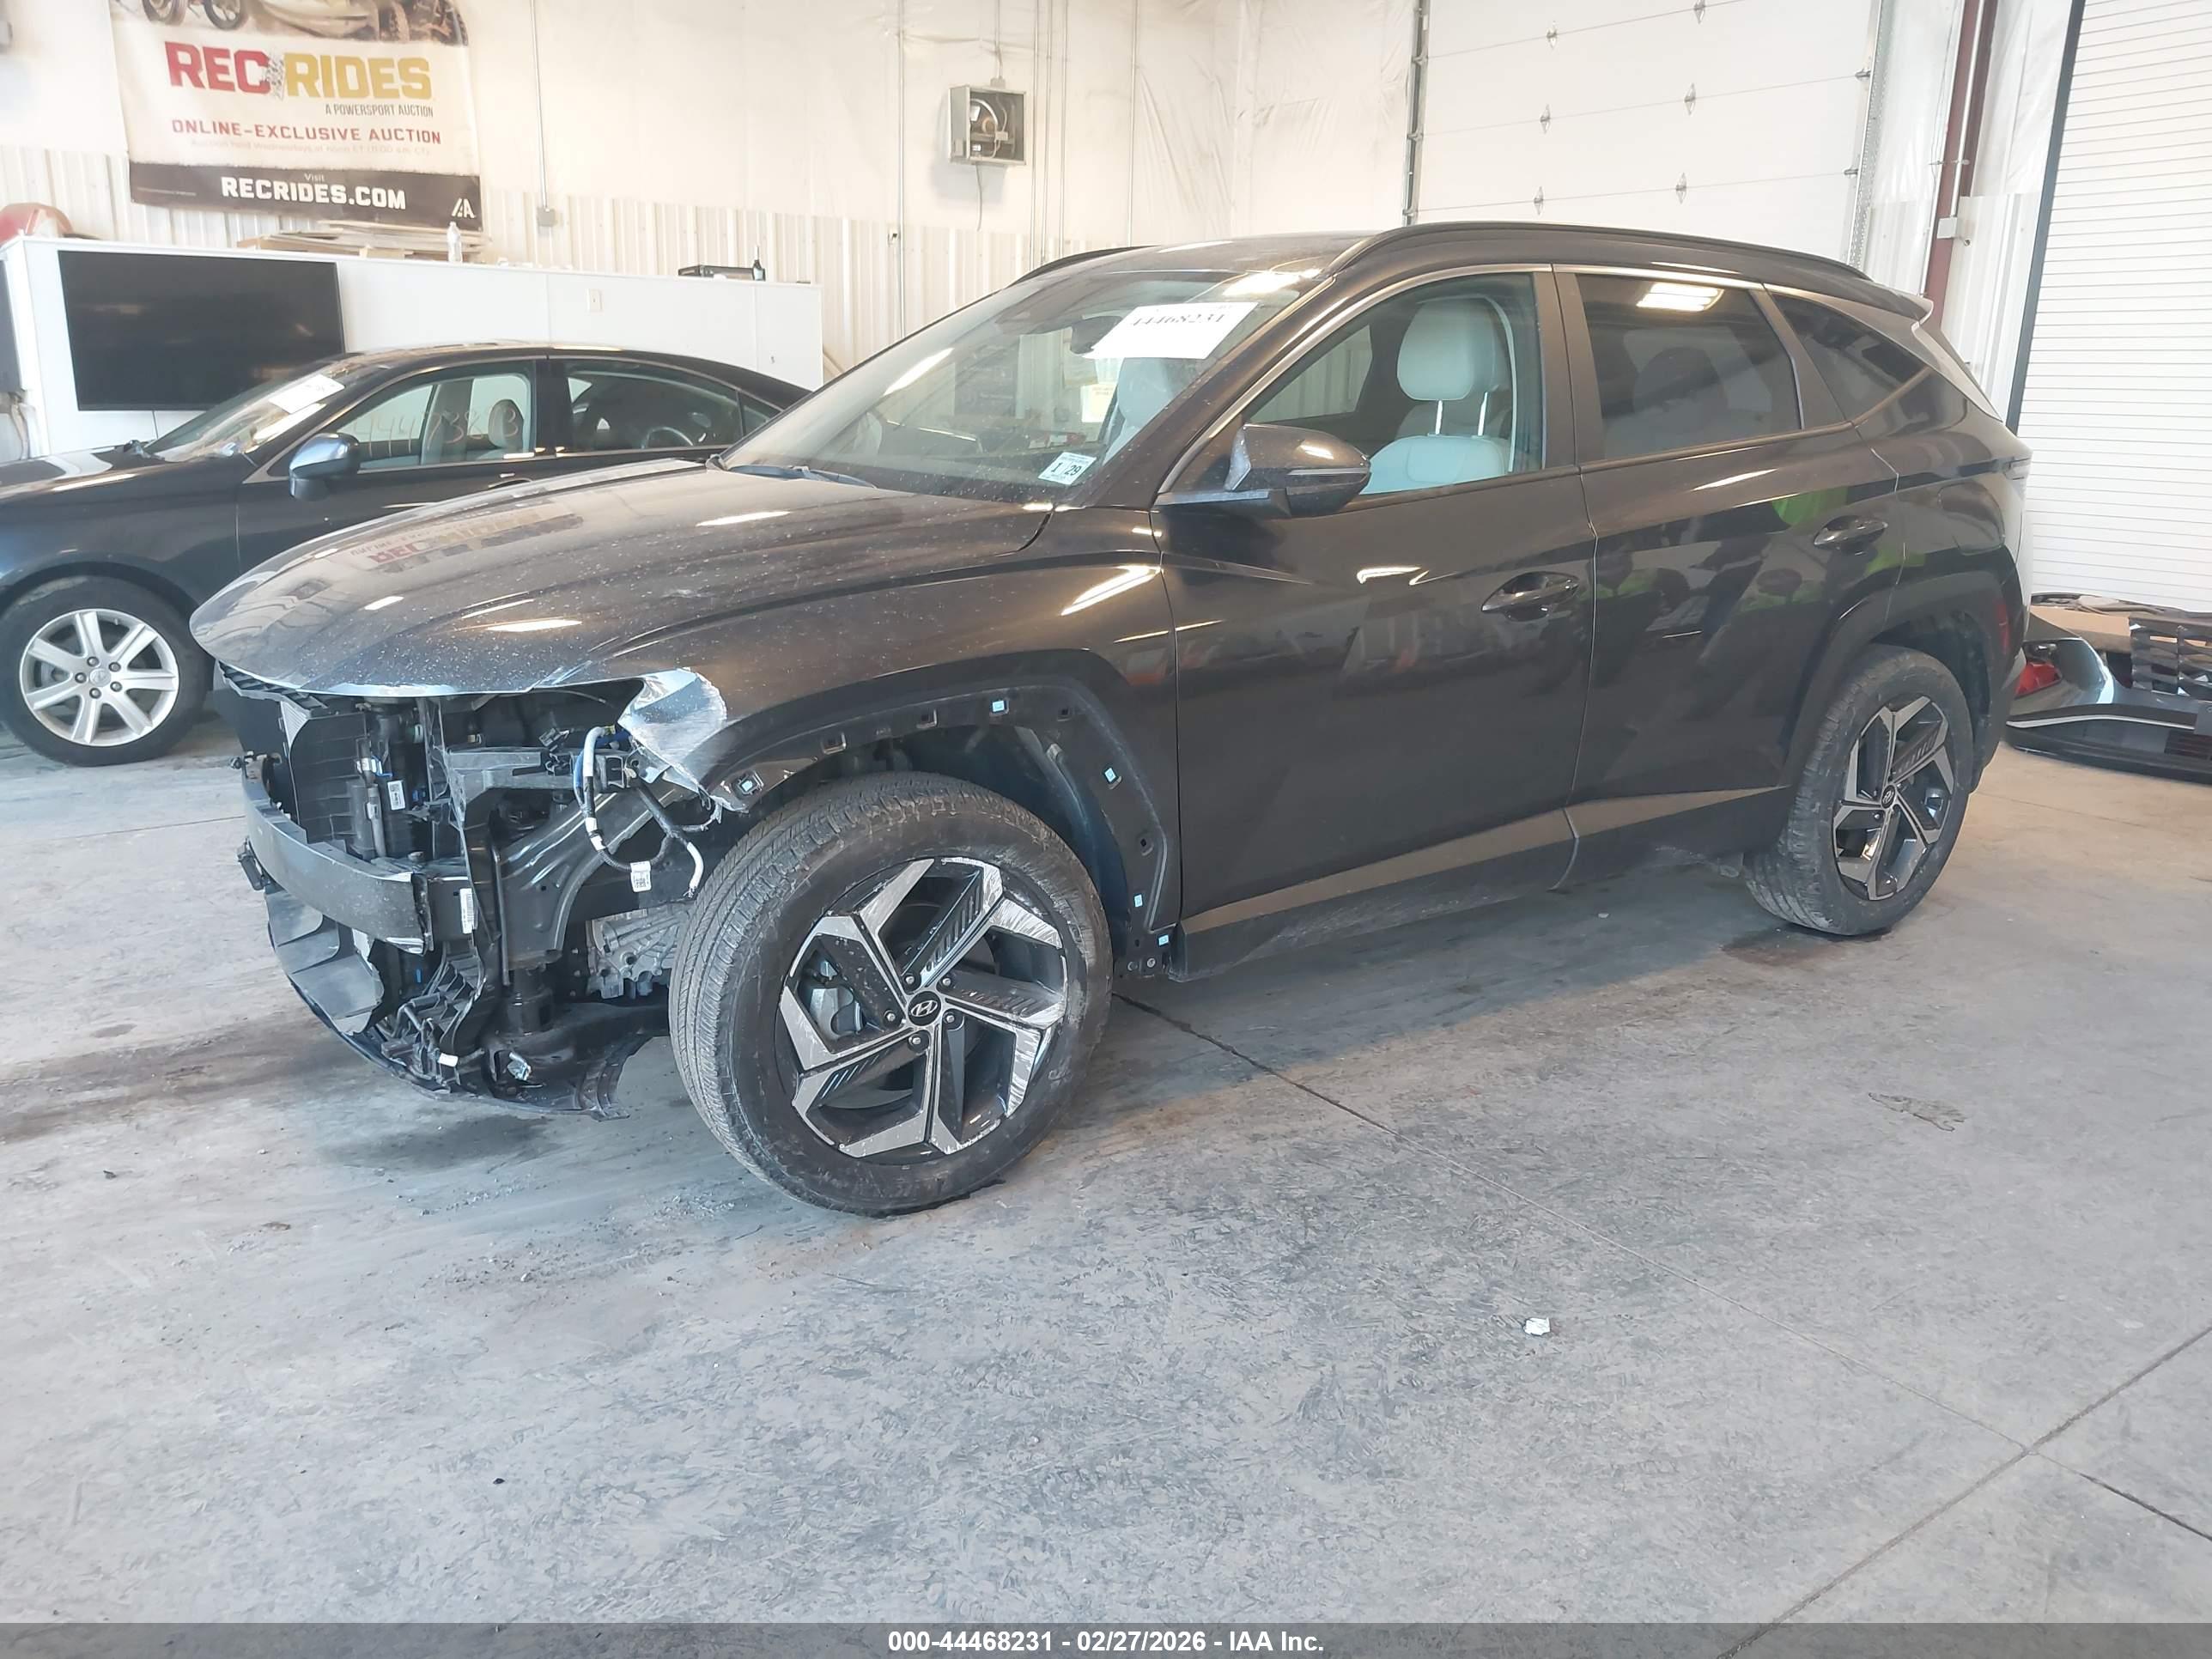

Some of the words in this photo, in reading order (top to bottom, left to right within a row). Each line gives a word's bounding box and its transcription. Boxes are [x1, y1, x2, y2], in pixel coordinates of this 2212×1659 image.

[164, 41, 271, 94] REC
[283, 52, 432, 100] RIDES
[325, 103, 332, 115] A
[333, 103, 396, 117] POWERSPORT
[398, 104, 434, 118] AUCTION
[172, 118, 362, 141] ONLINE-EXCLUSIVE
[368, 128, 441, 145] AUCTION
[304, 173, 325, 182] Visit
[221, 176, 406, 210] RECRIDES.COM
[1064, 465, 1082, 477] 29
